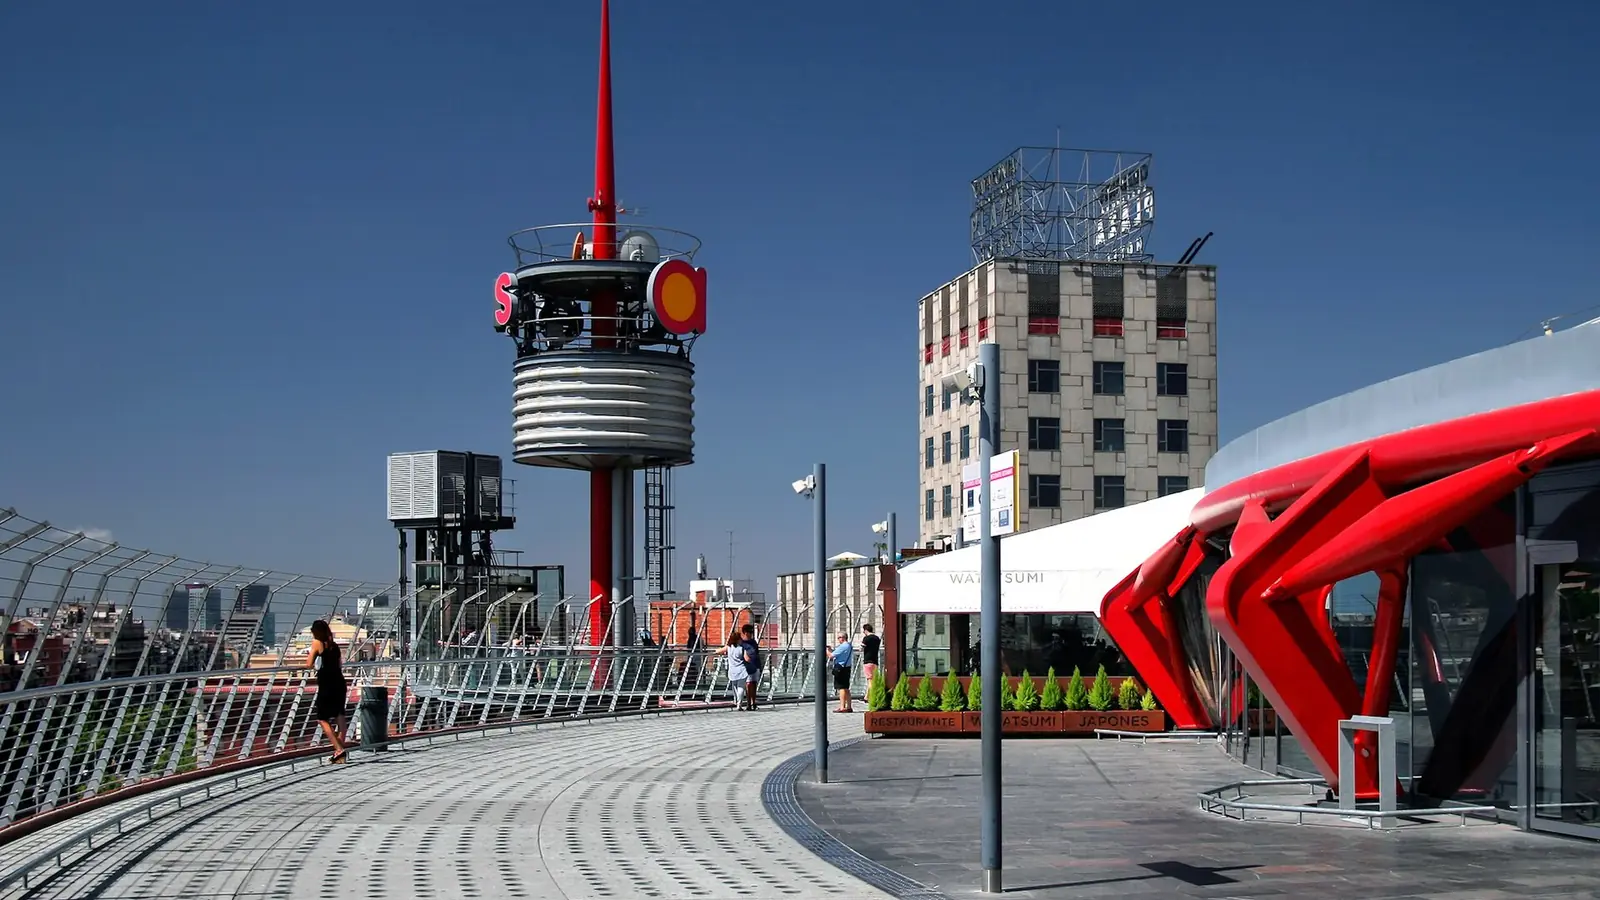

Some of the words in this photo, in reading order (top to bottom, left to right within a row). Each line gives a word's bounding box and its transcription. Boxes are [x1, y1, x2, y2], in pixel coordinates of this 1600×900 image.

[949, 572, 1044, 584] WATSUMI
[870, 716, 956, 727] RESTAURANTE
[970, 715, 1056, 727] WATSUMI
[1079, 715, 1150, 727] JAPONES
